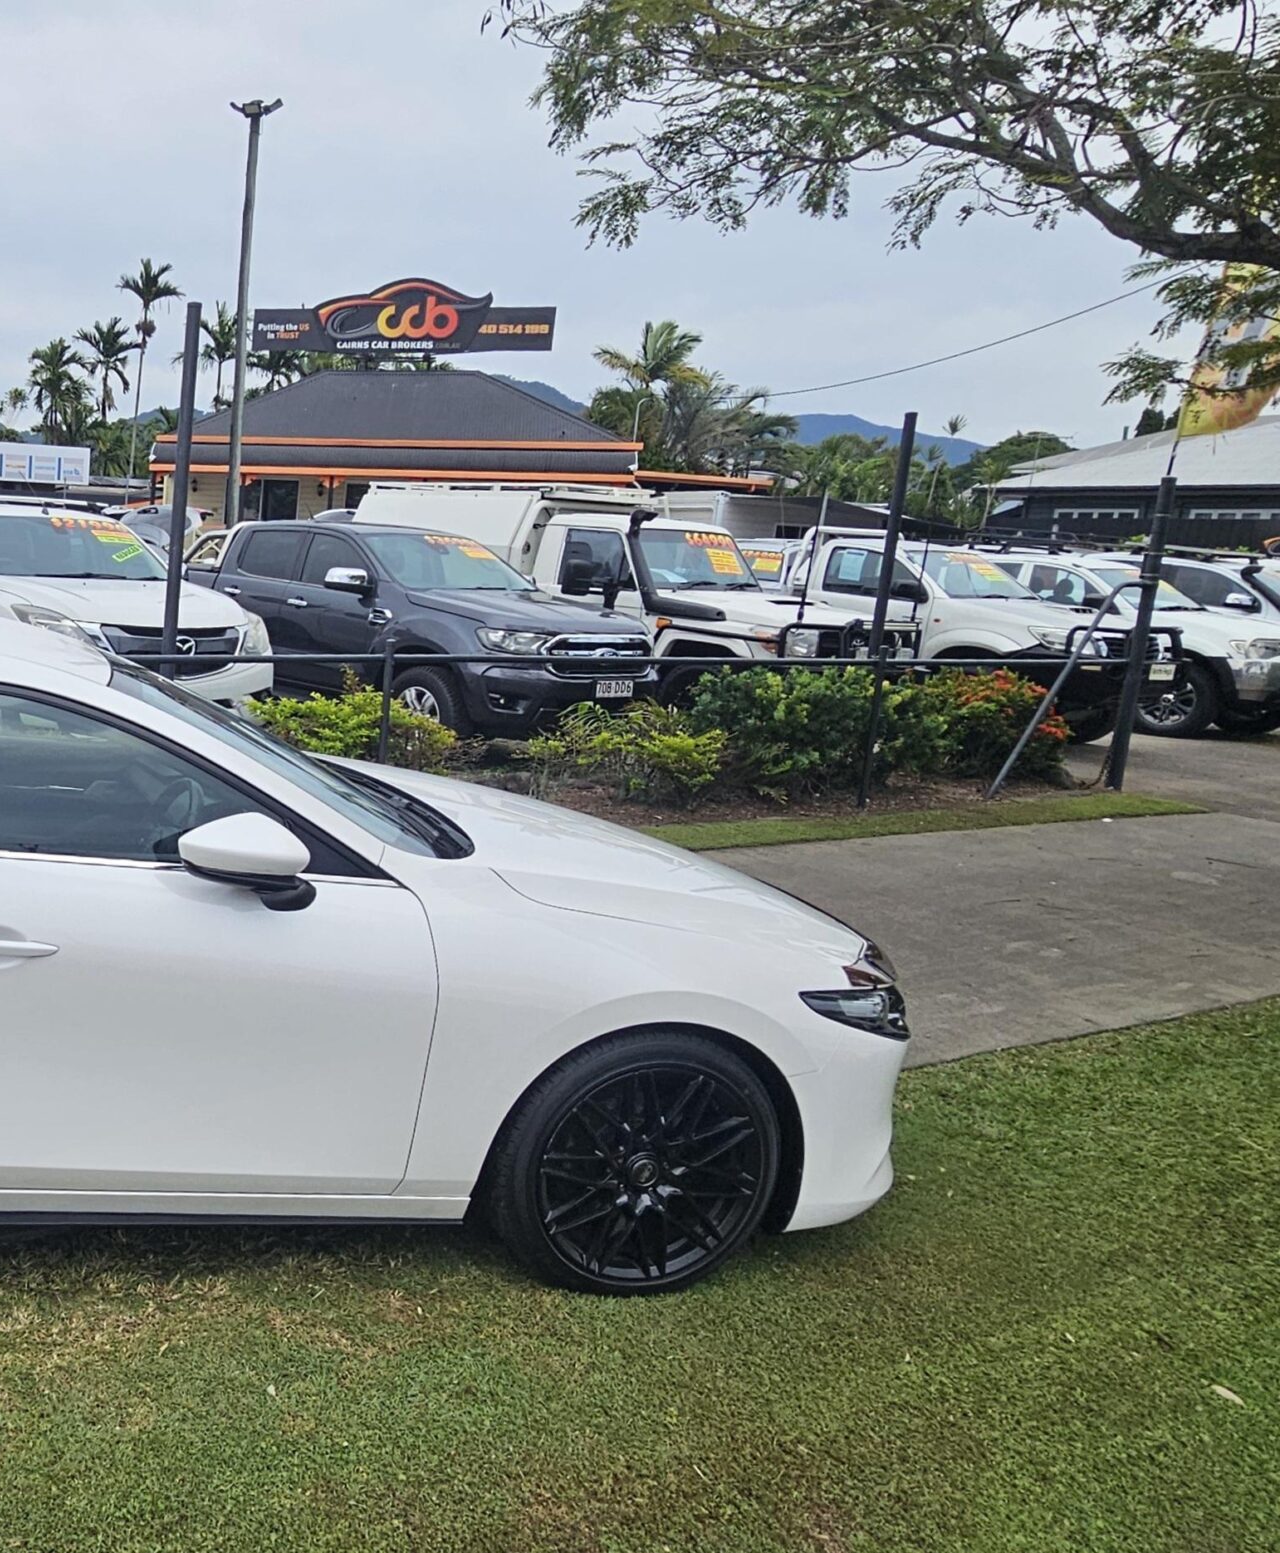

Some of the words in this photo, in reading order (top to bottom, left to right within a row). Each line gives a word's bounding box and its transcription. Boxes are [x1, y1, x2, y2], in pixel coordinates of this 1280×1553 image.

[258, 323, 285, 332] Putting
[286, 323, 298, 331] the
[299, 323, 310, 331] US
[478, 324, 496, 334] 40
[498, 324, 523, 334] 514
[336, 341, 369, 349] CAIRNS
[371, 341, 390, 349] CAR
